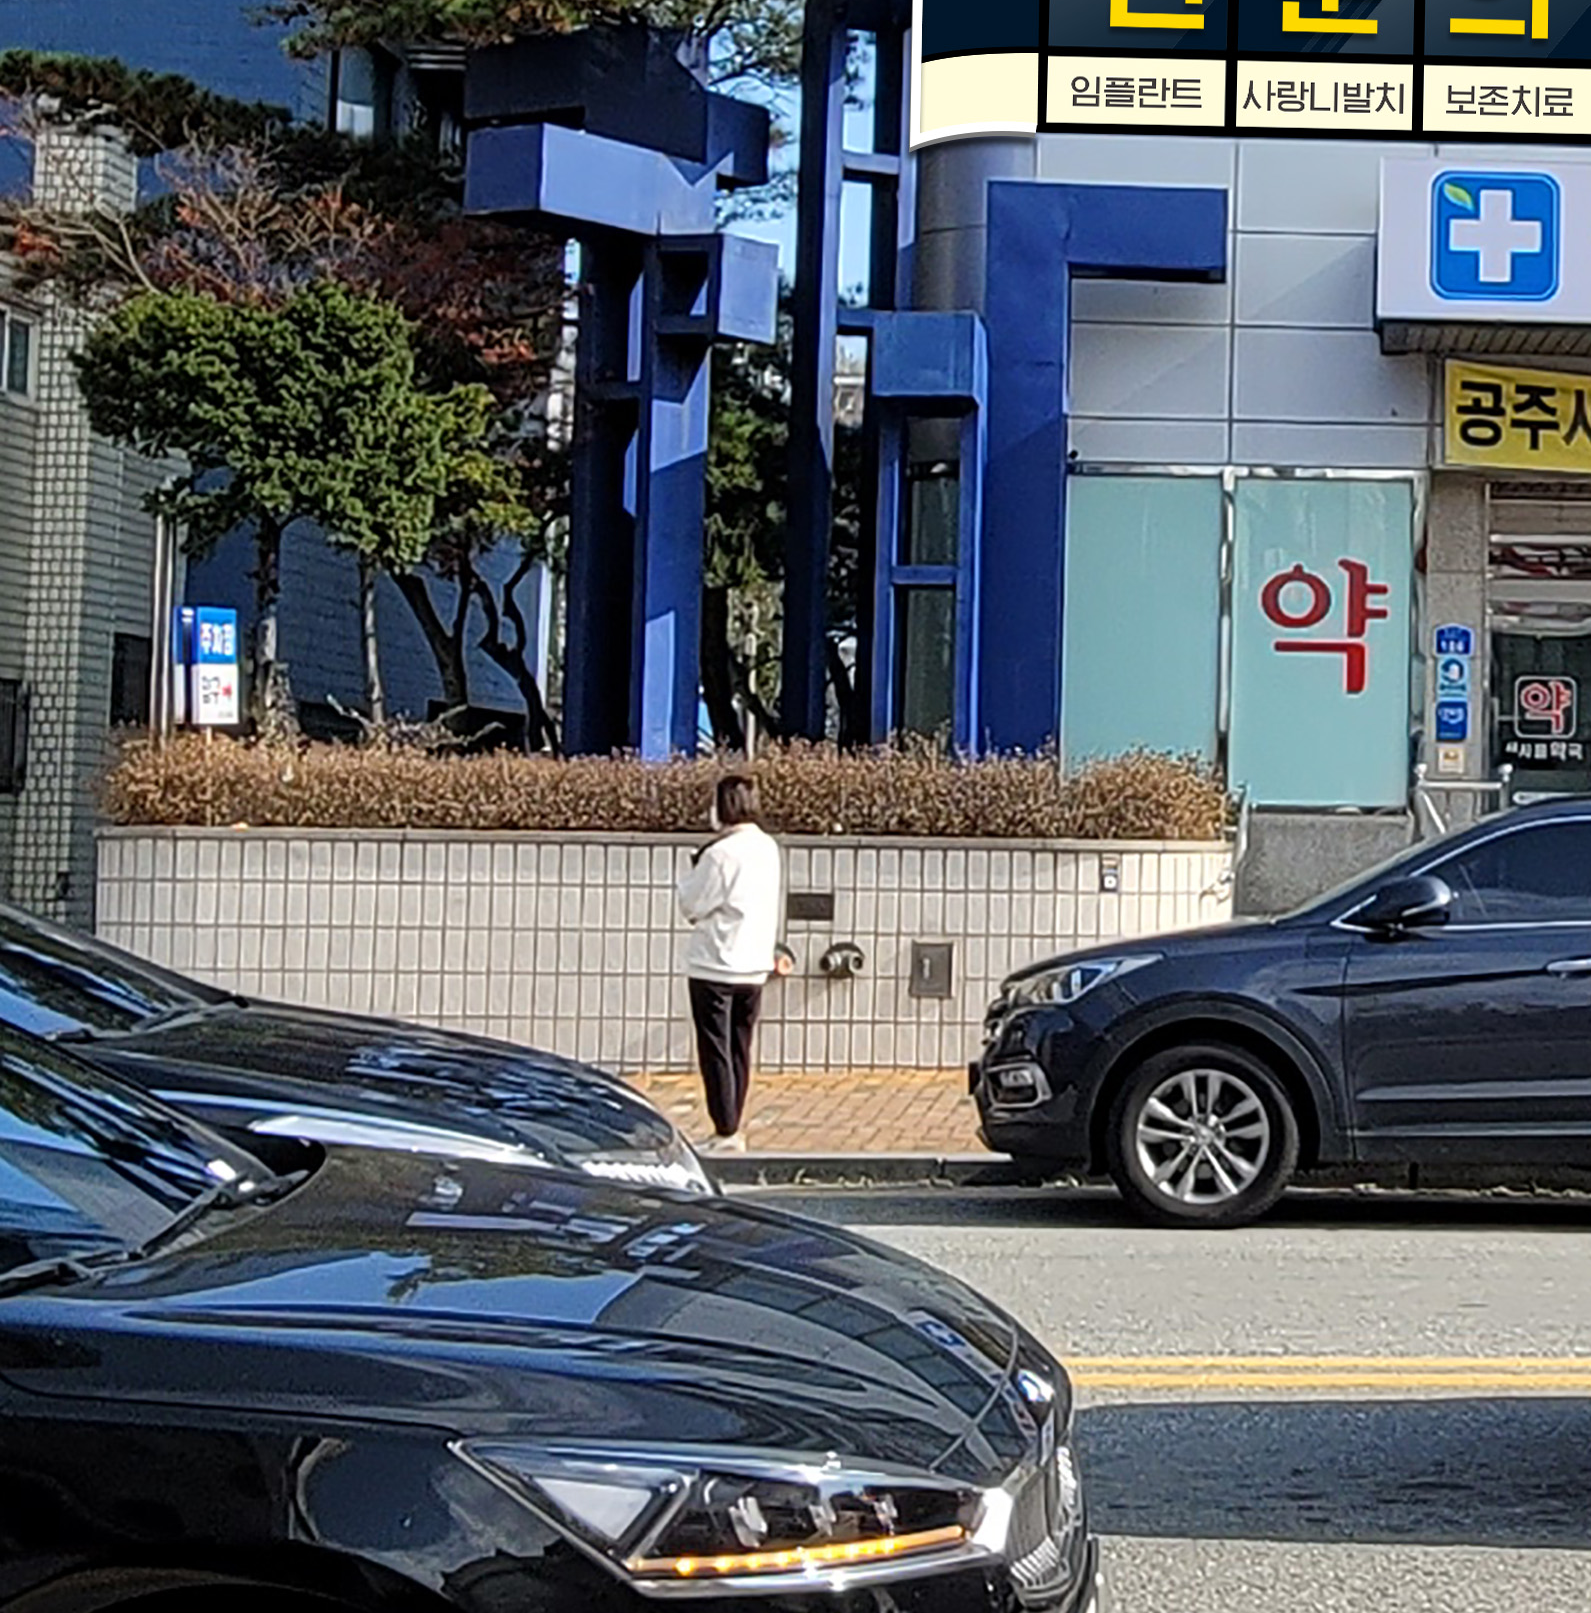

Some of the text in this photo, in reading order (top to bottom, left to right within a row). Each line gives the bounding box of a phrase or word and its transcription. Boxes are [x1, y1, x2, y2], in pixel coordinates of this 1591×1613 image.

[1068, 74, 1204, 117] 임플란트
[1240, 76, 1407, 118] 사랑니발치
[1443, 82, 1576, 121] 보존치료
[1261, 558, 1388, 694] 약
[1521, 681, 1571, 734] 약
